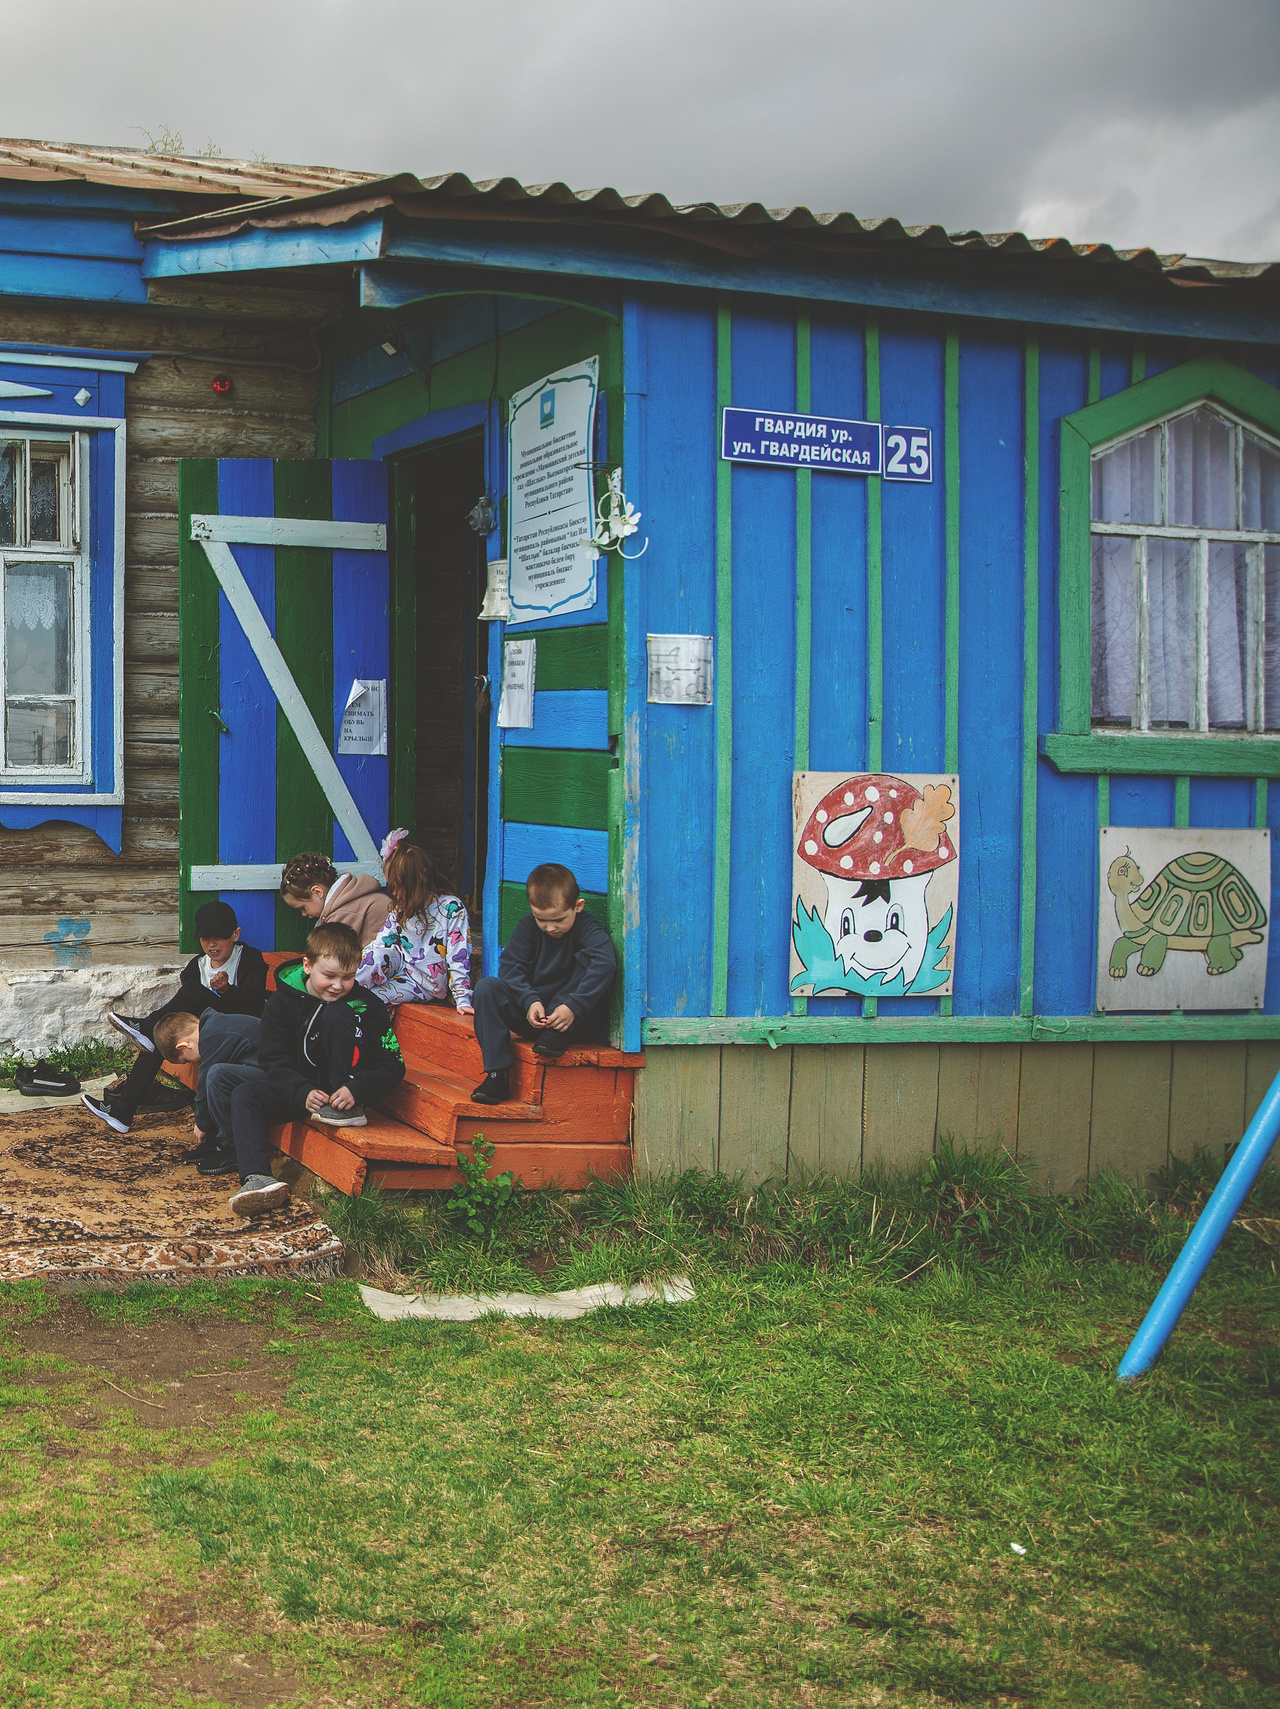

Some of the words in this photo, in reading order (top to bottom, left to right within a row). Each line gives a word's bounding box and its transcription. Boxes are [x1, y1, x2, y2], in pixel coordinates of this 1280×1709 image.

[754, 417, 827, 439] ГВАРДИЯ
[830, 427, 853, 443] ур.
[732, 440, 756, 455] ул.
[760, 441, 871, 465] ГВАРДЕЙСКАЯ
[886, 435, 929, 474] 25
